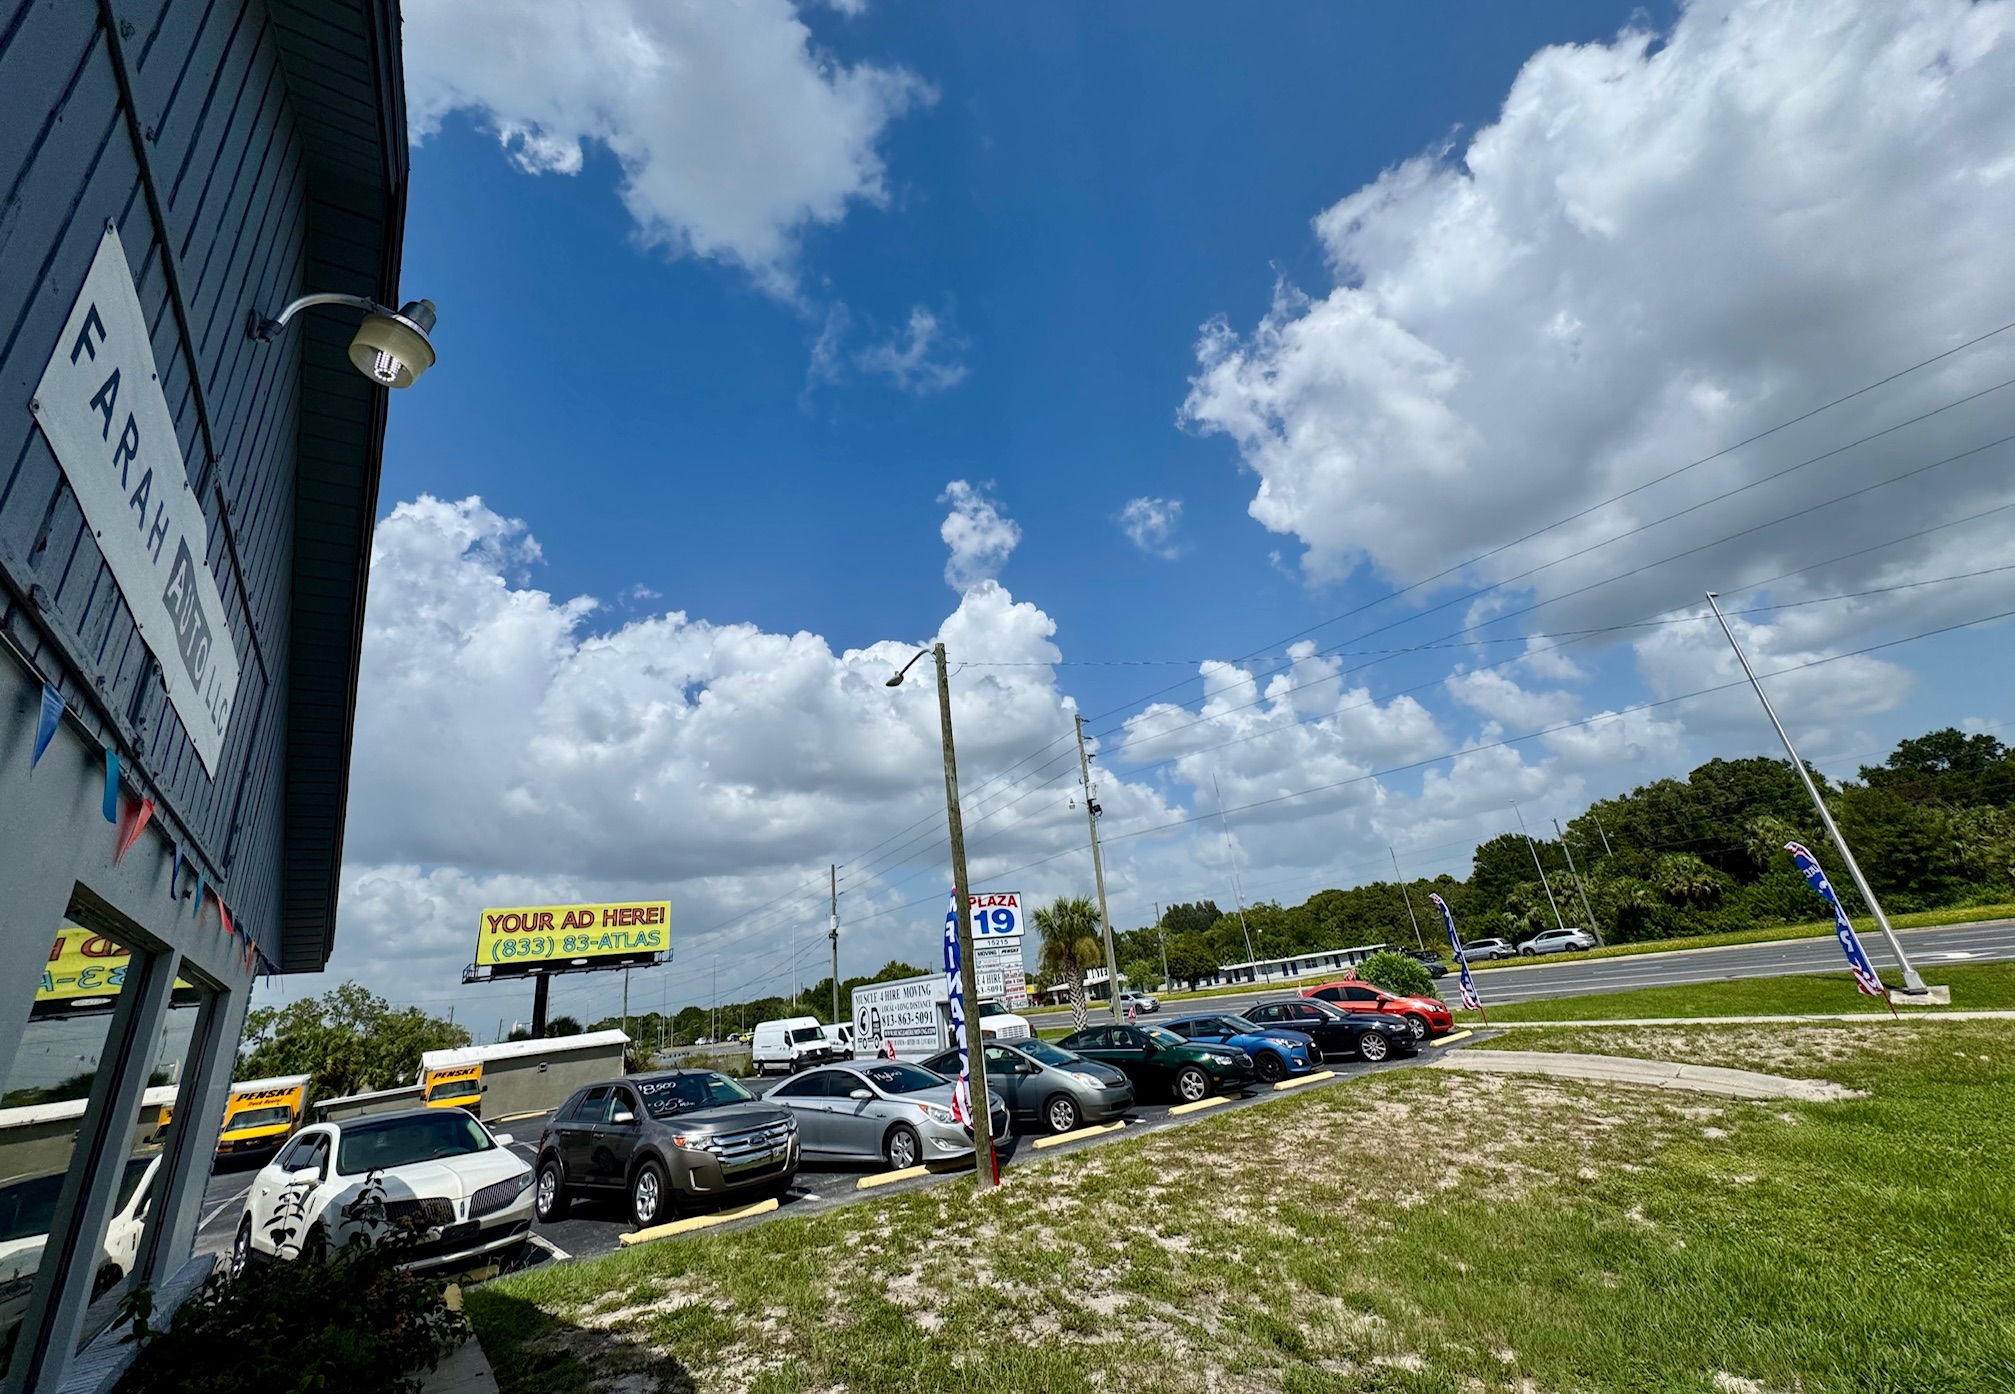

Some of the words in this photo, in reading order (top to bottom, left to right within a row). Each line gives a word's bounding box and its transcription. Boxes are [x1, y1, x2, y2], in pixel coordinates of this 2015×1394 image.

[71, 302, 170, 565] FARAH
[167, 558, 208, 681] AUTO
[204, 666, 228, 737] LLC
[968, 895, 1018, 910] PLAZA
[487, 912, 555, 934] YOUR
[560, 910, 595, 930] AD
[602, 907, 665, 927] HERE!
[974, 908, 1015, 934] 19
[492, 936, 555, 962] (833)
[563, 930, 661, 953] 83-ATLAS
[986, 973, 1002, 985] HIRE
[855, 992, 877, 1005] MUSCLE
[880, 991, 884, 1002] 4
[884, 988, 901, 1001] HIRE
[903, 983, 932, 998] MOVING
[881, 1004, 895, 1013] LOCAL
[909, 1000, 932, 1010] DISTANCE
[881, 1010, 933, 1027] 813-863-5091
[432, 1067, 478, 1080] PENSKE
[235, 1086, 299, 1102] PENSKE
